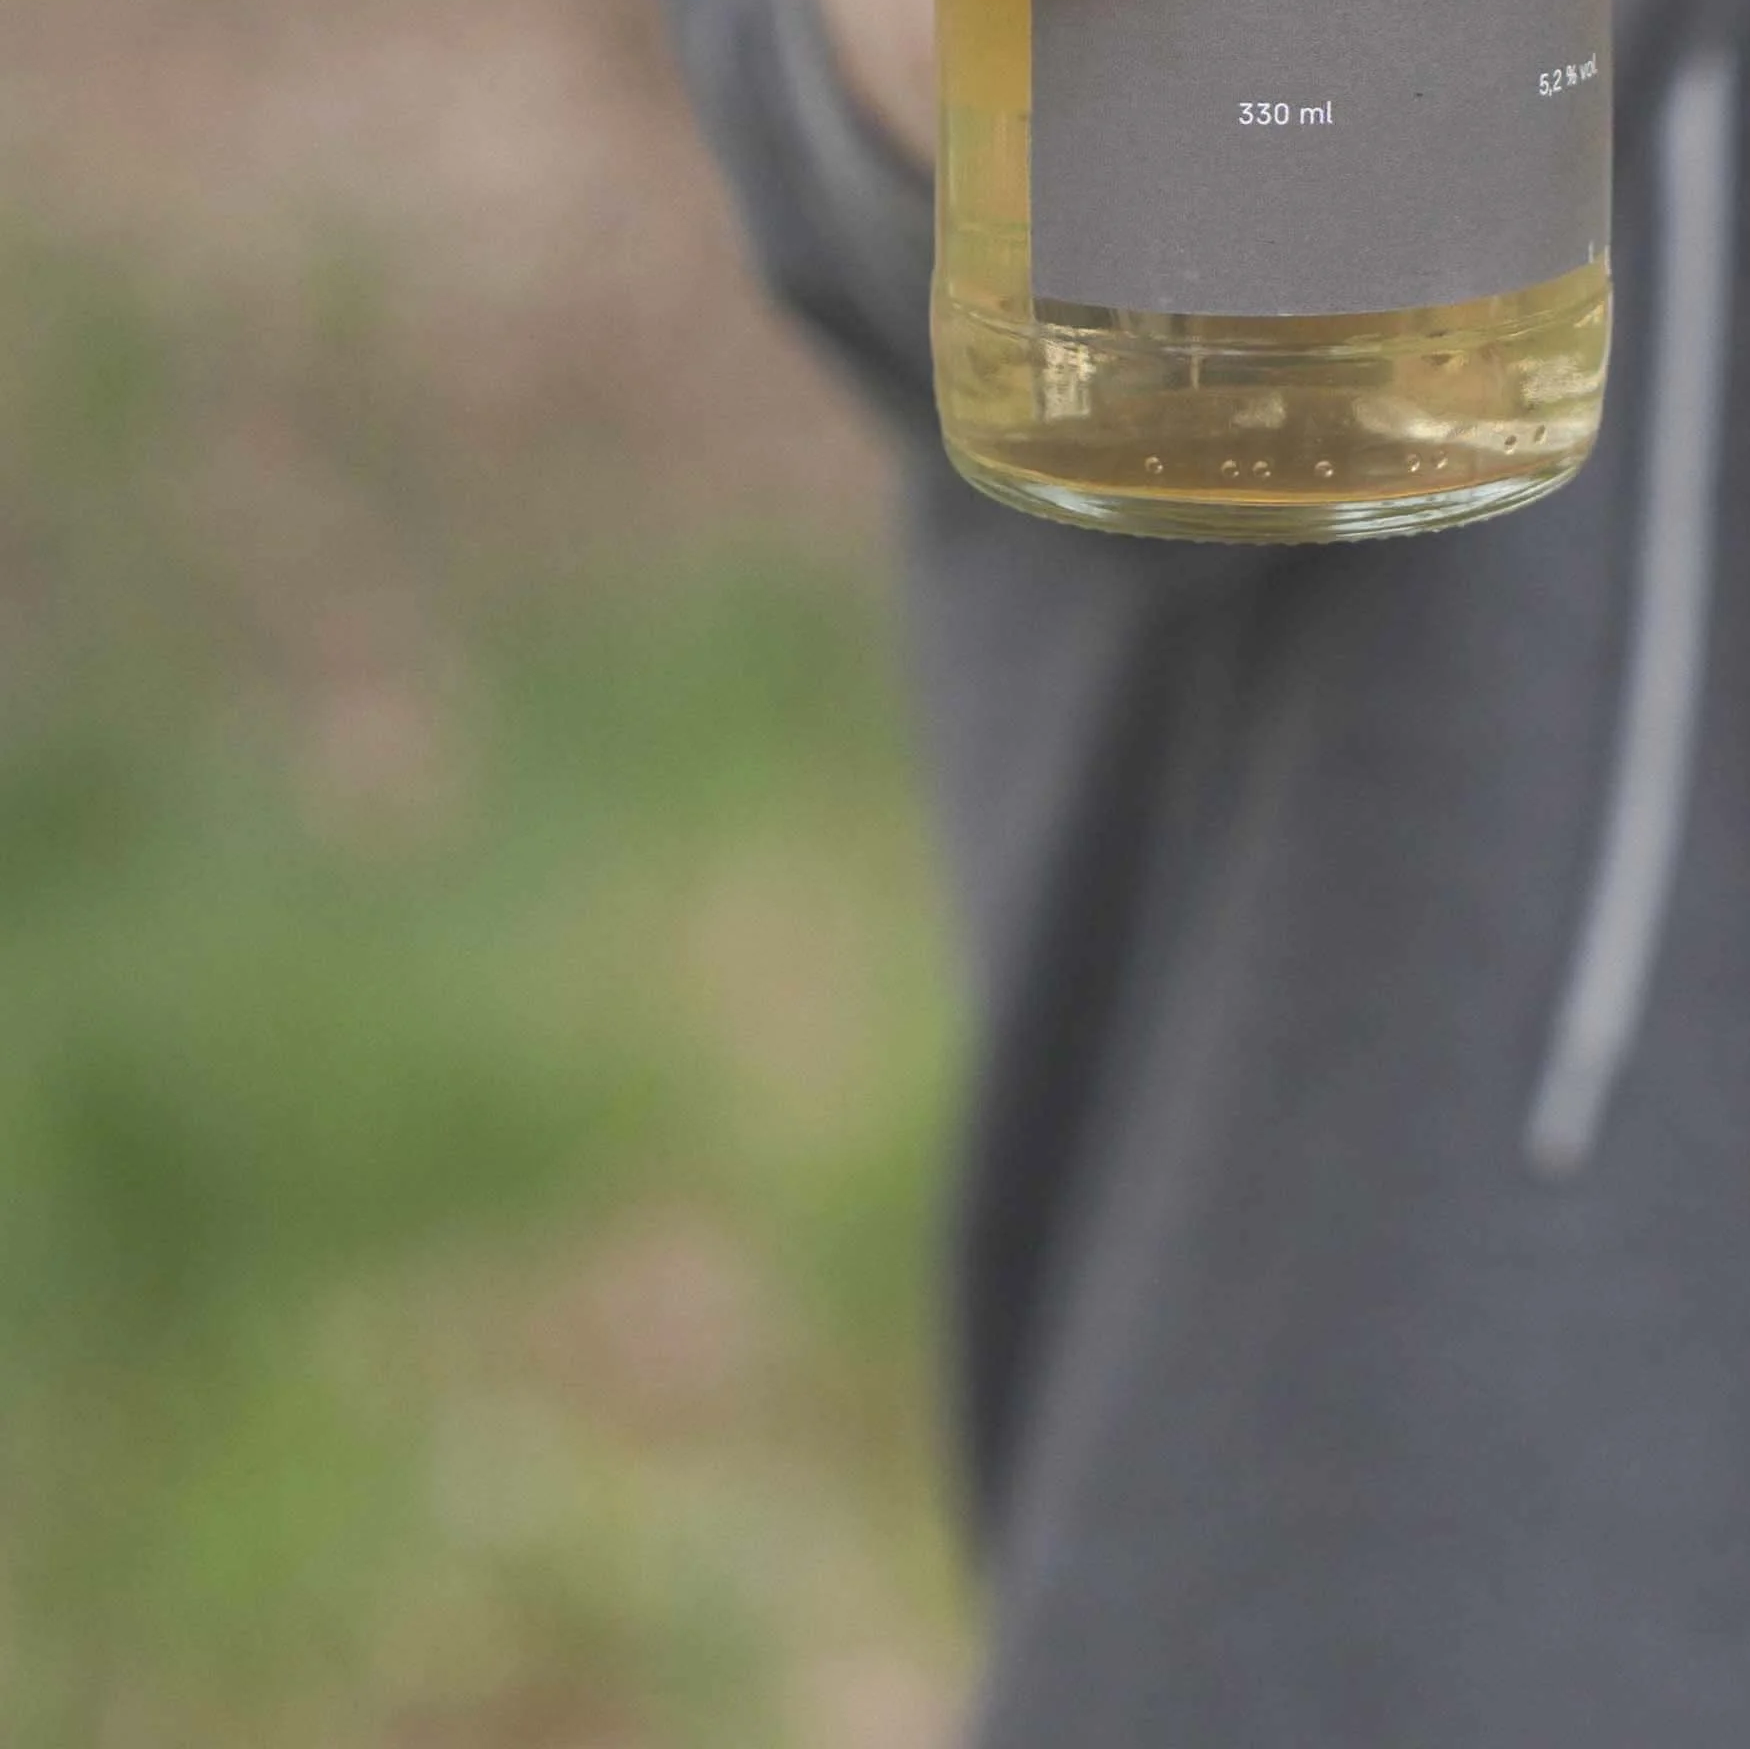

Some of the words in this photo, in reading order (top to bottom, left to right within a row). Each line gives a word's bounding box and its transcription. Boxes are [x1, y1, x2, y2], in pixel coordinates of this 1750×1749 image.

[1539, 68, 1563, 97] 5,2
[1238, 102, 1290, 125] 330
[1300, 100, 1334, 125] ml
